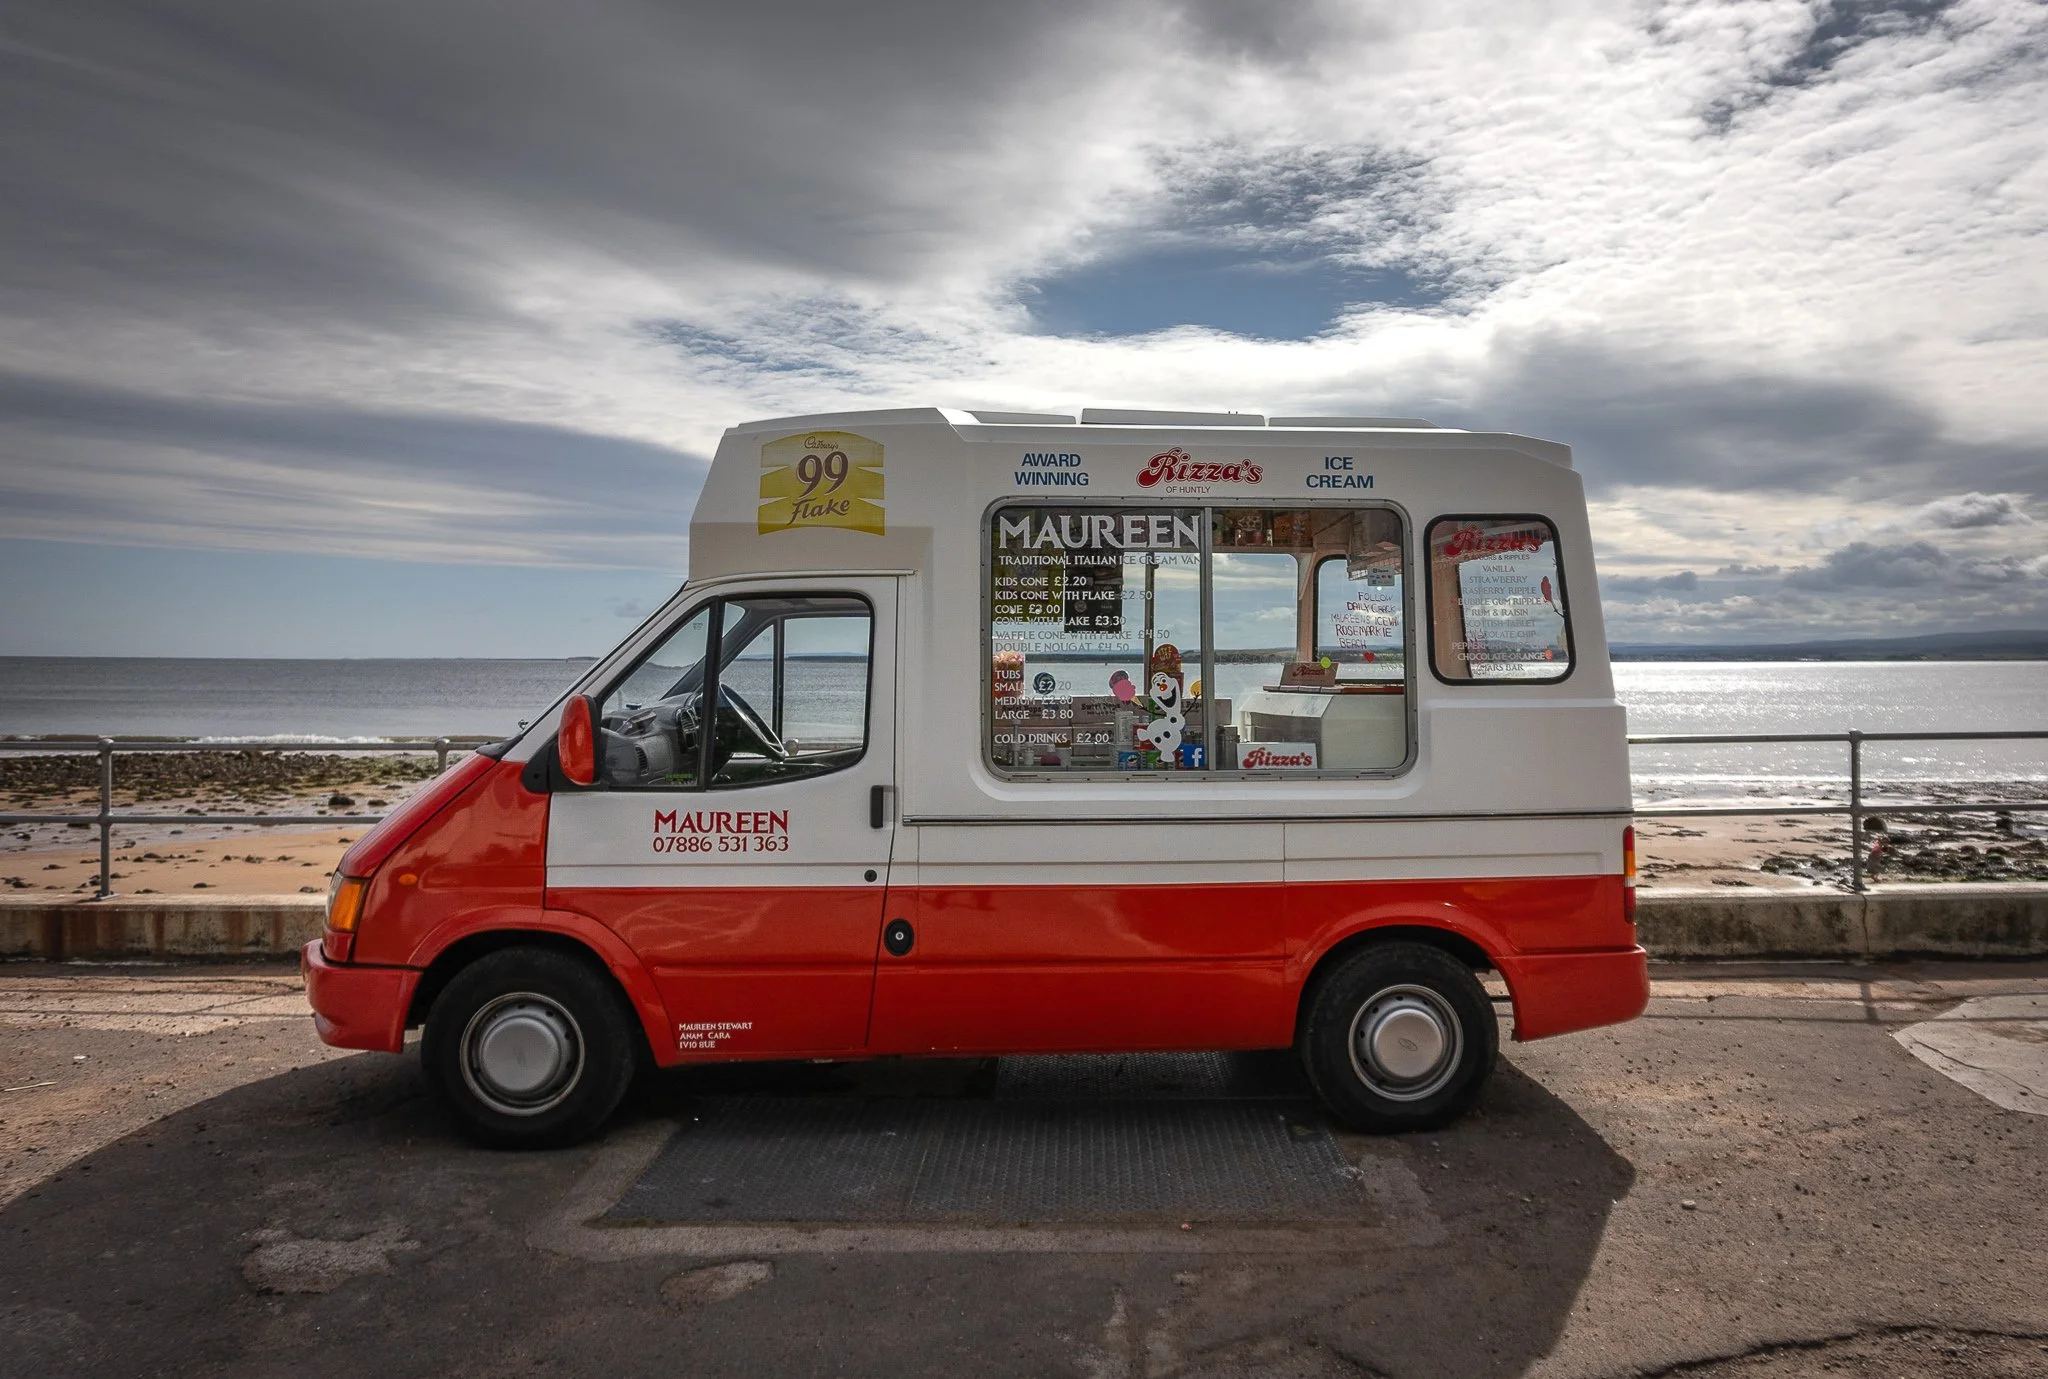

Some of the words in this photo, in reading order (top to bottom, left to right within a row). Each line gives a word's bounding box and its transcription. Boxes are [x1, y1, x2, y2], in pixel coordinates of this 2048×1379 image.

[1021, 453, 1081, 467] AWARD
[1325, 457, 1353, 470] ICE
[1136, 447, 1263, 489] Rizza's
[796, 451, 849, 499] 99
[1014, 472, 1089, 486] WINNING
[1306, 474, 1374, 489] CREAM
[1166, 486, 1177, 494] OF
[1179, 486, 1211, 494] HUNTLY
[787, 497, 850, 525] Flake
[998, 515, 1200, 550] MAUREEN
[999, 555, 1071, 565] TRADITIONAL
[1074, 555, 1117, 565] ITALIAN
[1119, 555, 1136, 565] ICE
[1138, 555, 1178, 565] CREAM
[1180, 555, 1201, 565] VAN
[1482, 565, 1515, 573] VANILLA
[995, 577, 1018, 586] KIDS
[1020, 577, 1048, 586] CONE
[1054, 576, 1087, 586] £2.20
[995, 591, 1018, 600] KIDS
[1020, 591, 1048, 600] CONE
[1052, 591, 1080, 600] WITH
[1082, 591, 1115, 600] FLAKE
[1121, 590, 1153, 600] £2.50
[1358, 592, 1393, 602] FOLLOW
[1492, 598, 1511, 606] GUM
[994, 605, 1023, 614] CONE
[1029, 604, 1061, 614] £3.00
[994, 617, 1023, 626] CONE
[1026, 617, 1055, 626] WITH
[1057, 617, 1090, 626] FLAKE
[1095, 615, 1126, 626] £3.30
[995, 630, 1036, 640] WAFFLE
[1038, 630, 1068, 640] CONE
[1069, 630, 1097, 640] WITH
[1100, 630, 1132, 640] FLAKE
[1137, 630, 1170, 639] £4.50
[1336, 624, 1392, 637] ROSEMARKIE
[995, 642, 1042, 652] DOUBLE
[1044, 642, 1093, 652] NOUGAT
[1098, 642, 1129, 652] £4.50
[995, 670, 1021, 679] TUBS
[1038, 680, 1072, 691] £2.20
[1041, 695, 1074, 705] £2.80
[995, 710, 1030, 720] LARGE
[1041, 709, 1074, 719] £3.80
[994, 734, 1026, 744] COLD
[1028, 733, 1068, 744] DRINKS
[1076, 733, 1110, 743] £2.00
[1242, 746, 1313, 769] Rizza's
[653, 809, 789, 834] MAUREEN
[653, 836, 712, 852] 07886
[718, 836, 747, 852] 531
[753, 836, 789, 852] 363
[679, 1023, 716, 1031] MAUREEN
[717, 1022, 753, 1030] STEWART
[680, 1032, 703, 1040] ANAM
